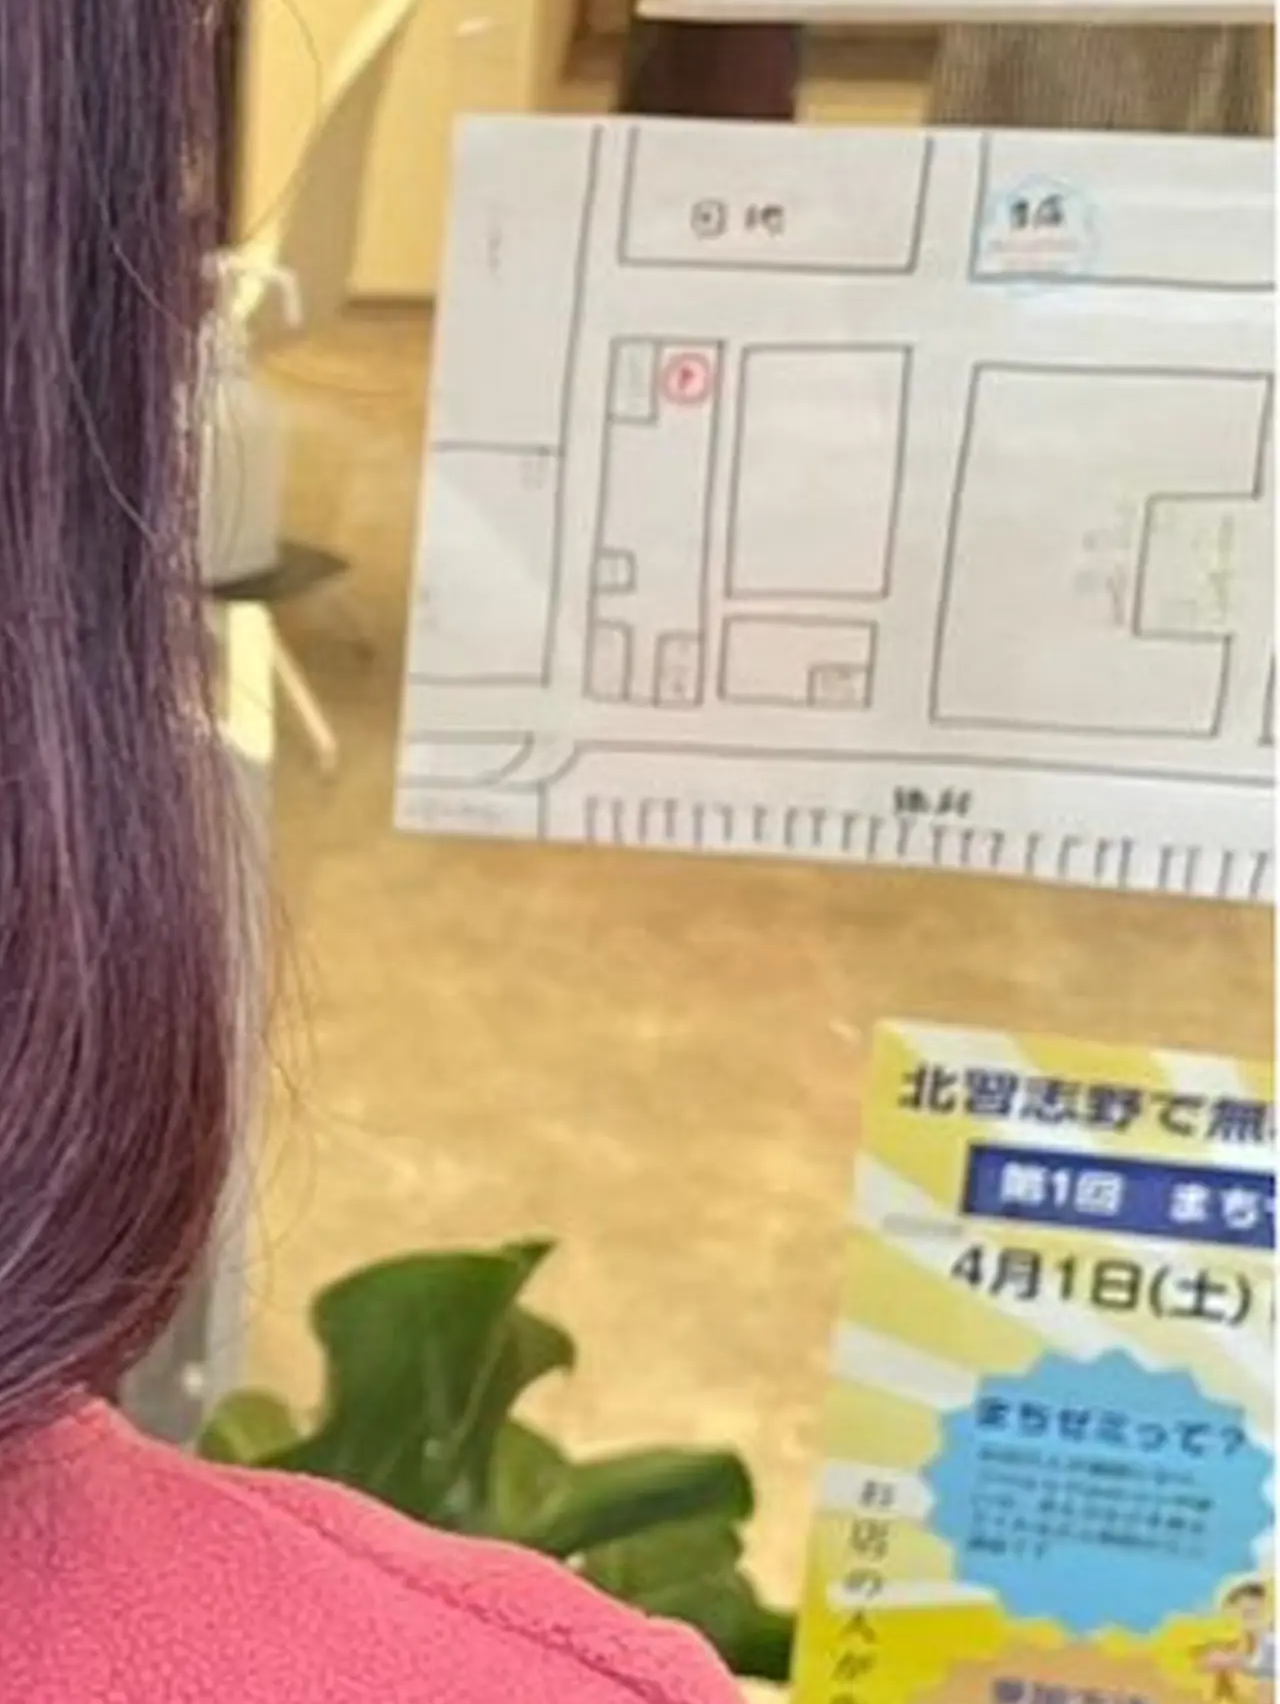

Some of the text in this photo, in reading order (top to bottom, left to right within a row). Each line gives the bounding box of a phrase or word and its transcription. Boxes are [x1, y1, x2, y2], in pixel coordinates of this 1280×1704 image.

[896, 1063, 1275, 1142] 北習志野で無
[1000, 1161, 1275, 1231] 第1回 まち
[950, 1244, 1252, 1325] 4月1日(土)
